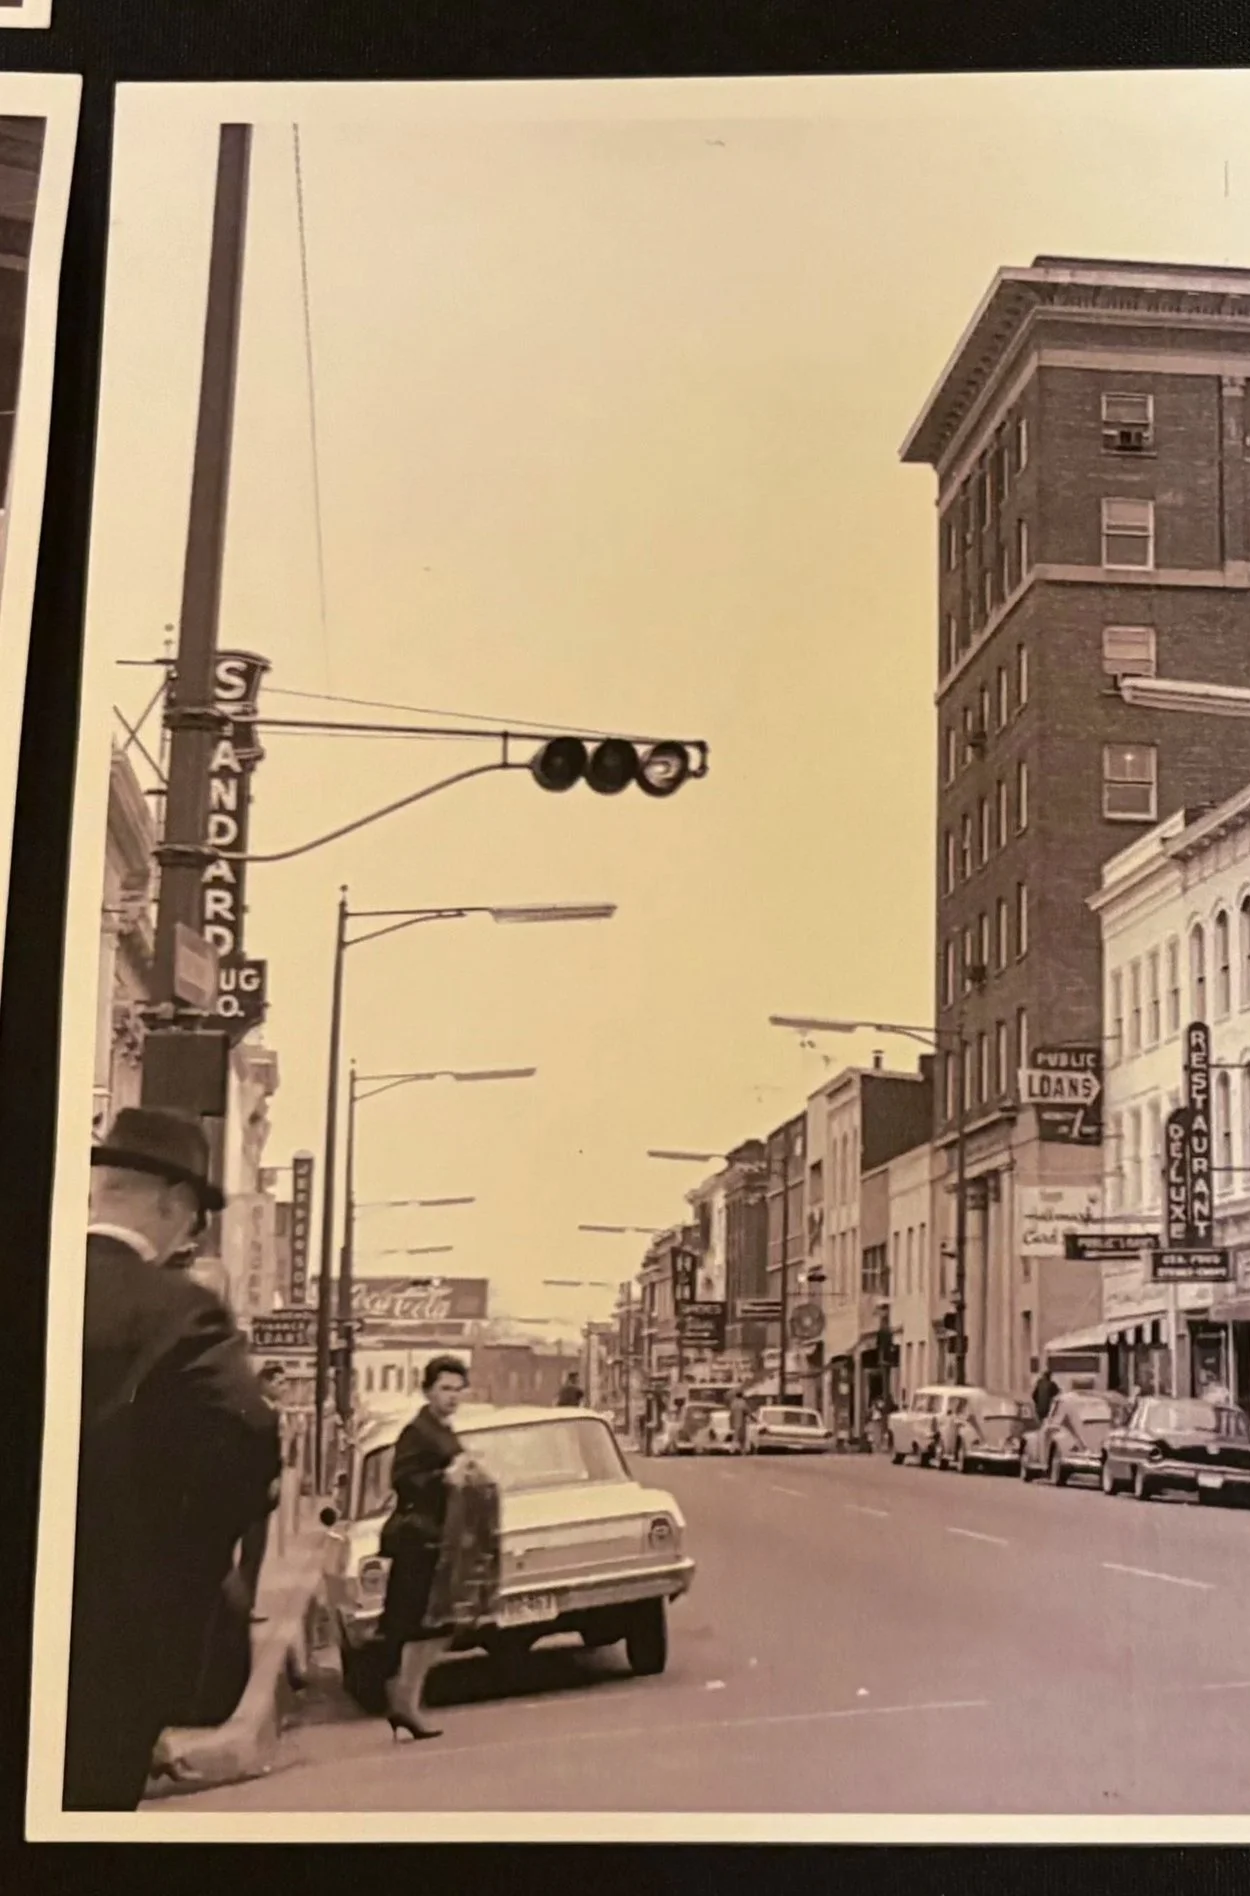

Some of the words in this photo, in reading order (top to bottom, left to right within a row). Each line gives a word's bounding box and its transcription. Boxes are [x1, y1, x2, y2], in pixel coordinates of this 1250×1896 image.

[219, 967, 261, 992] UG
[216, 995, 245, 1018] O.
[1037, 1052, 1097, 1067] PUBLIC
[1027, 1073, 1093, 1098] LOANS
[1189, 1029, 1210, 1238] RESTAURANT
